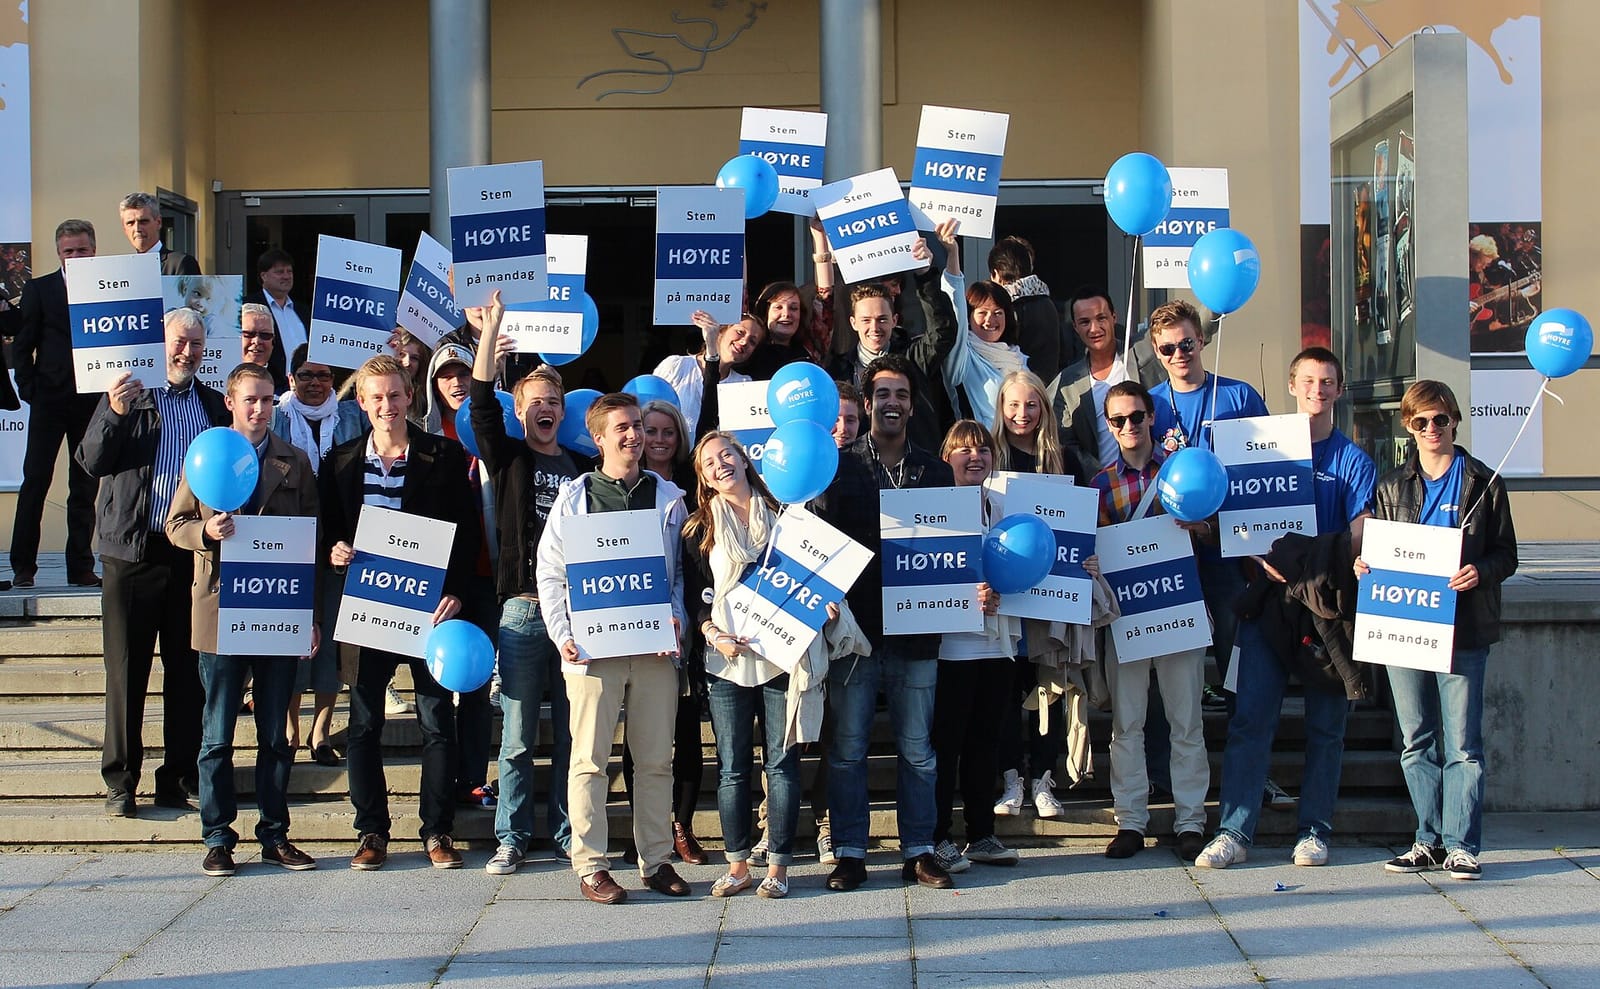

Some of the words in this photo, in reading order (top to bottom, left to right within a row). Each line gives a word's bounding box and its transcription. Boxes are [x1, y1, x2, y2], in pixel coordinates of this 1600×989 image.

[769, 125, 797, 135] Stem
[948, 130, 976, 141] Stem
[925, 161, 987, 182] HØYRE
[480, 188, 512, 201] Stem
[778, 187, 809, 198] ndag
[843, 189, 872, 204] Stem
[687, 211, 716, 221] Stem
[920, 200, 934, 211] på
[937, 203, 983, 218] mandag
[838, 211, 899, 238] HØYRE
[464, 224, 531, 248] HØYRE
[668, 248, 730, 265] HØYRE
[850, 251, 865, 264] på
[867, 242, 911, 260] mandag
[345, 261, 373, 274] Stem
[1156, 258, 1171, 268] på
[98, 279, 130, 290] Stem
[466, 273, 483, 286] på
[486, 269, 535, 282] mandag
[325, 292, 385, 317] HØYRE
[416, 276, 461, 319] HØYRE
[667, 292, 683, 304] på
[686, 292, 731, 303] mandag
[83, 314, 150, 334] HØYRE
[407, 304, 425, 320] på
[422, 314, 446, 337] mand
[506, 322, 521, 334] på
[524, 323, 569, 335] mandag
[321, 333, 337, 346] på
[340, 336, 384, 353] mandag
[87, 359, 101, 370] på
[105, 357, 154, 369] mandag
[787, 389, 814, 402] HØYRE
[1246, 440, 1278, 451] Stem
[1231, 475, 1298, 496] HØYRE
[914, 513, 947, 524] Stem
[1035, 505, 1065, 518] Stem
[1232, 522, 1248, 533] på
[1253, 520, 1303, 532] mandag
[253, 540, 284, 550] Stem
[388, 534, 419, 550] Stem
[597, 536, 630, 548] Stem
[1127, 542, 1159, 556] Stem
[799, 539, 830, 563] Stem
[1394, 547, 1426, 560] Stem
[896, 551, 967, 570] HØYRE
[233, 578, 299, 595] HØYRE
[360, 568, 429, 597] HØYRE
[582, 573, 653, 595] HØYRE
[757, 564, 824, 611] HØYRE
[1117, 574, 1185, 602] HØYRE
[1030, 586, 1079, 602] mandag
[1371, 584, 1441, 608] HØYRE
[896, 599, 912, 611] på
[917, 597, 970, 610] mandag
[231, 621, 246, 633] på
[251, 621, 299, 634] mandag
[351, 611, 367, 623] på
[371, 616, 421, 635] mandag
[587, 623, 603, 635] på
[608, 618, 660, 632] mandag
[734, 600, 750, 615] på
[750, 610, 795, 646] mandag
[1126, 627, 1141, 641] på
[1145, 616, 1195, 633] mandag
[1368, 630, 1383, 640] på
[1388, 632, 1438, 649] mandag
